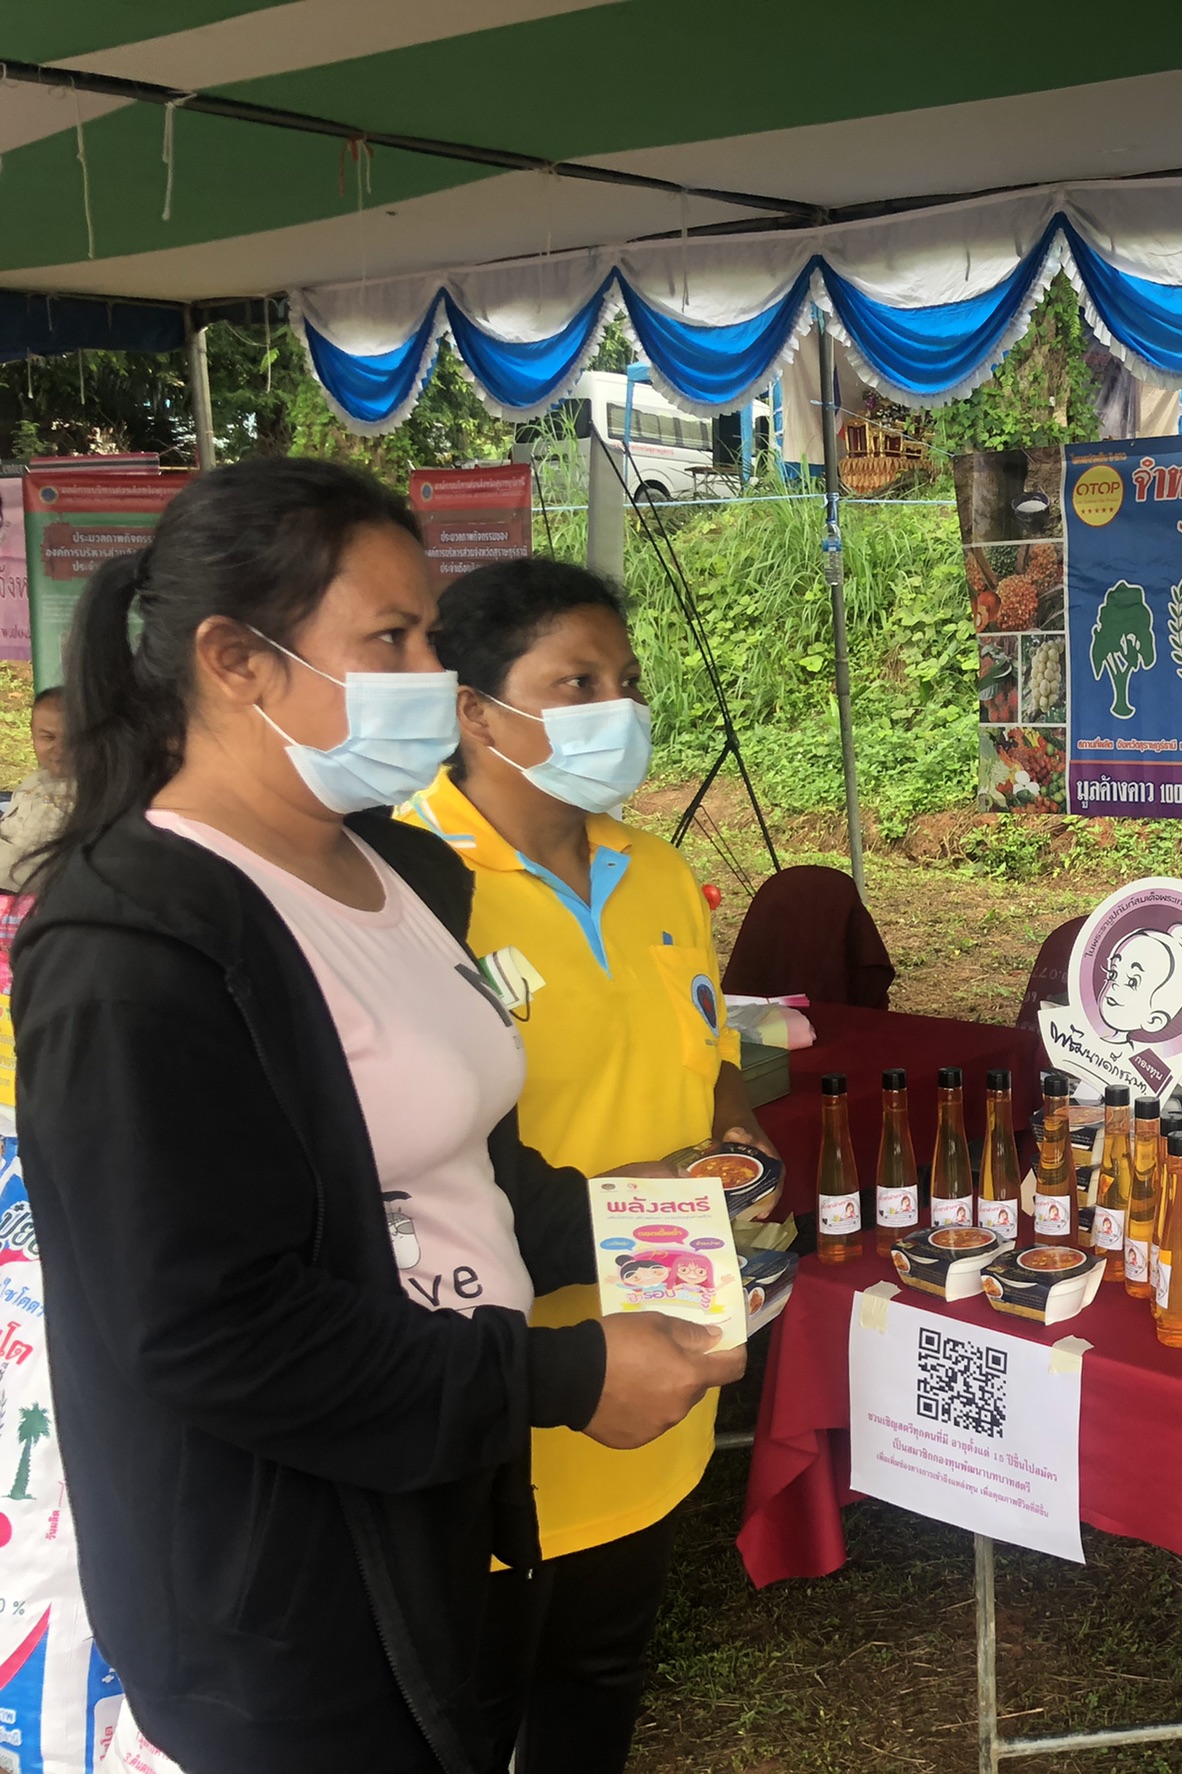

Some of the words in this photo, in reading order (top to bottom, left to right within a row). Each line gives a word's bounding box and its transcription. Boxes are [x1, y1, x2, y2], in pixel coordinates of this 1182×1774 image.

[1076, 481, 1121, 496] OTOP
[73, 532, 154, 544] ประมวลภาพกิจกรร
[1076, 775, 1155, 809] มูลค้างคาว
[1134, 1055, 1163, 1080] กองทุน
[607, 1196, 711, 1213] พลังสตรี
[892, 1437, 1031, 1493] เป็นสมาชิกกองทุนพัฒนาบทบาทสตรี
[951, 1437, 990, 1458] อายุตั้งแต่
[993, 1452, 1004, 1462] 15
[1007, 1453, 1058, 1482] ปีขึ้นไปสมัคร
